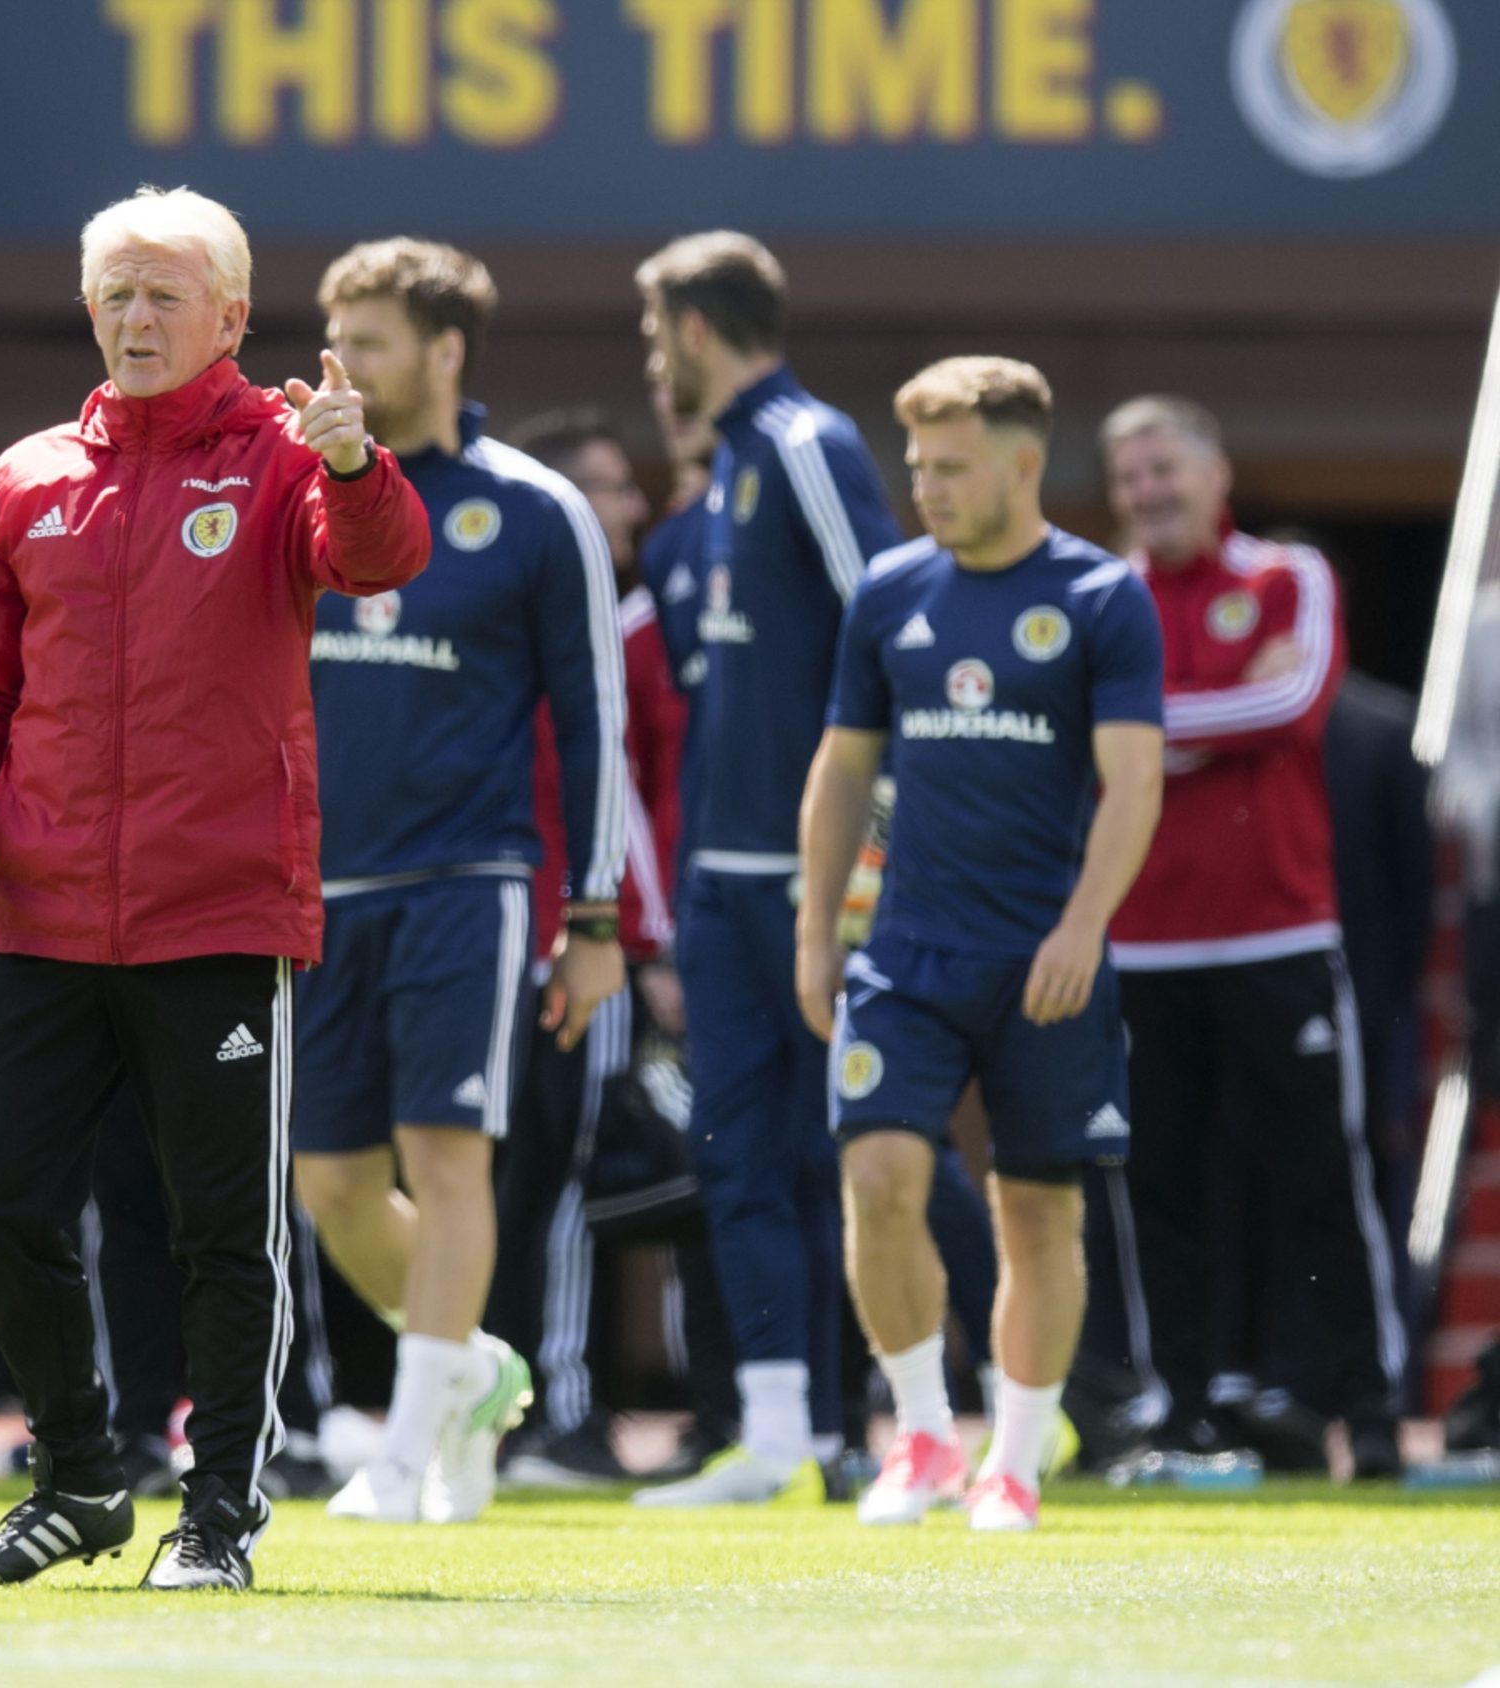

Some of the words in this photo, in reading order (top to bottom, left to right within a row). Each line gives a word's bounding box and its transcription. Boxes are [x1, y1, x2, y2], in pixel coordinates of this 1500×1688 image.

[106, 0, 562, 147] THIS
[620, 0, 1160, 144] TIME.
[27, 525, 68, 539] adidas
[216, 1042, 264, 1062] adidas
